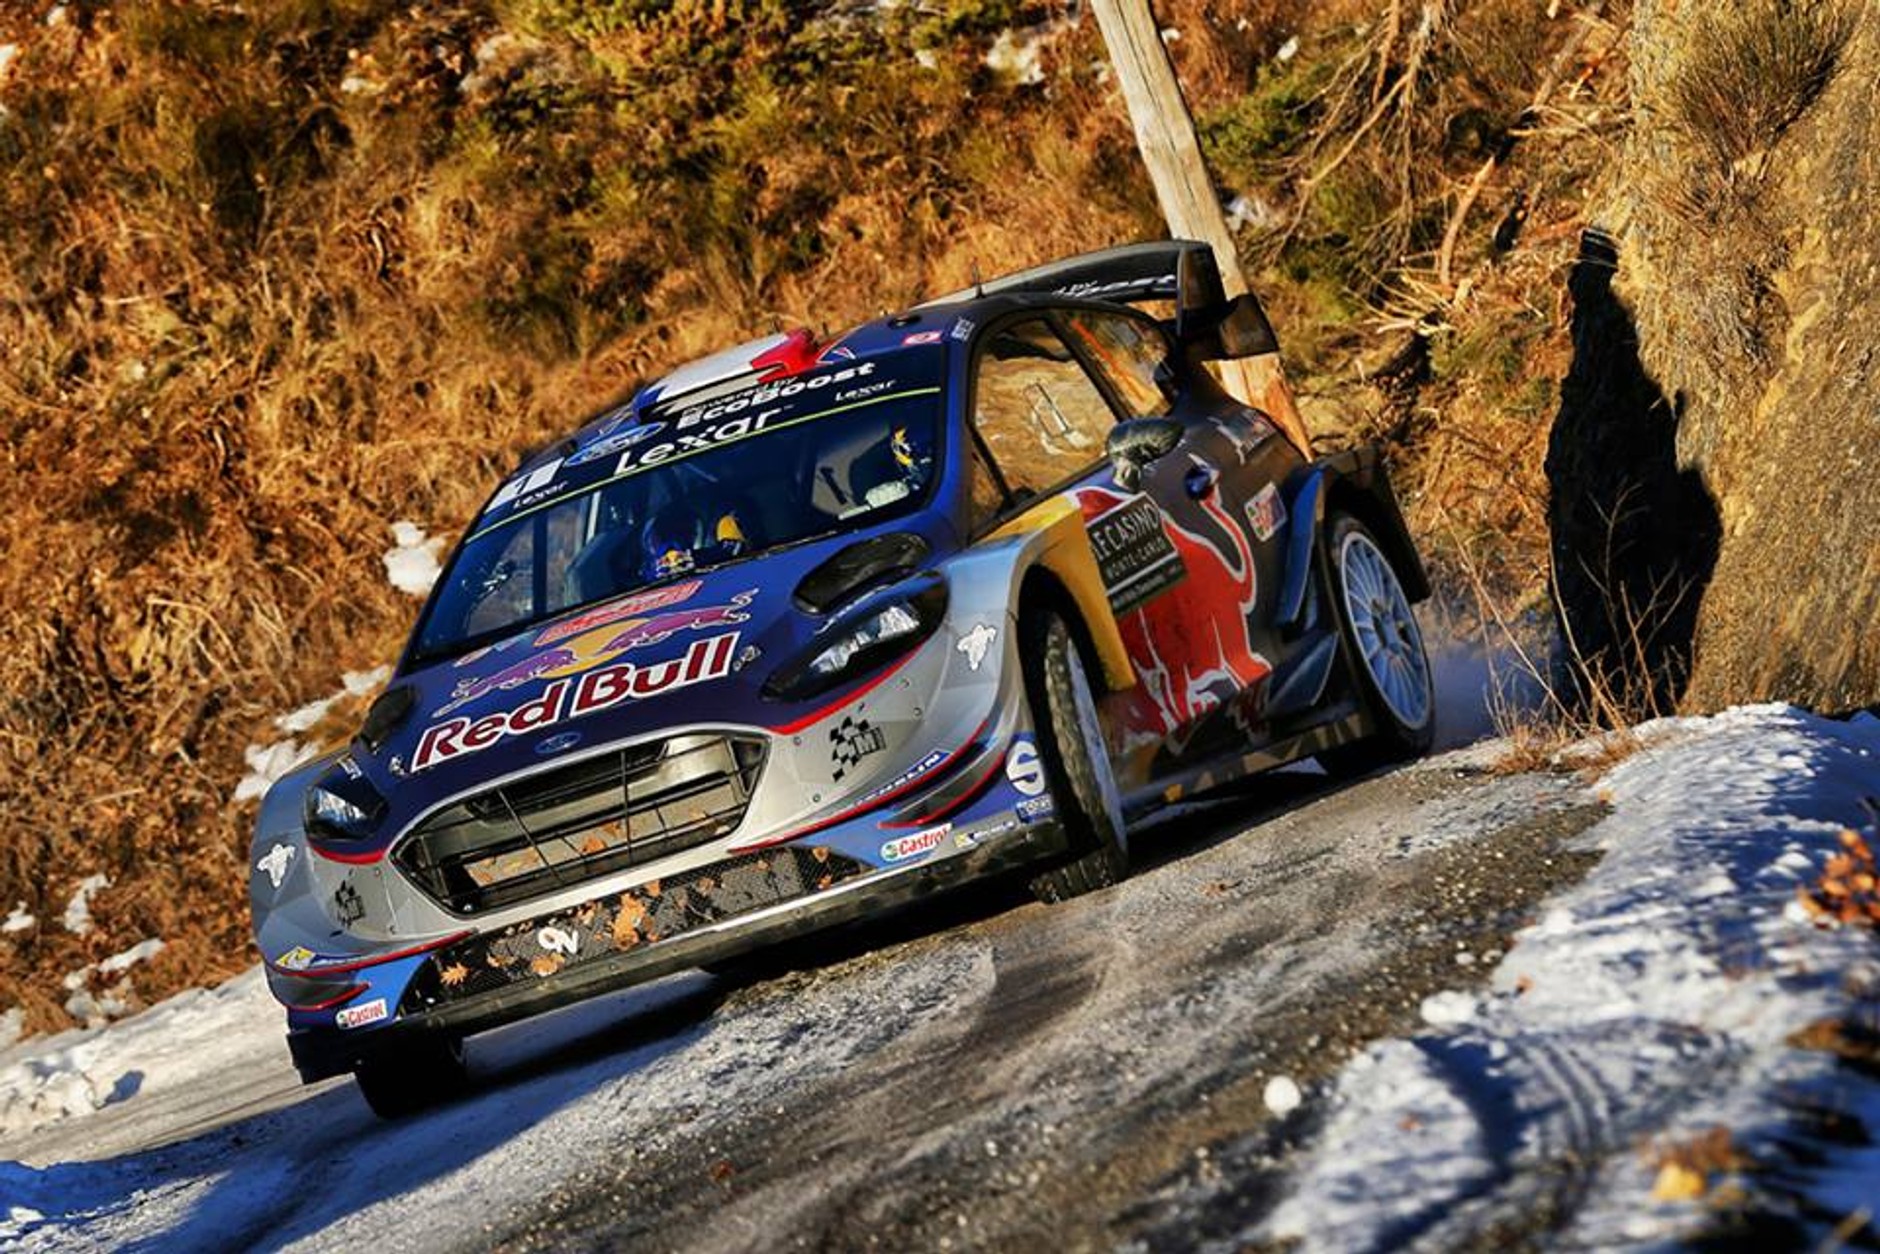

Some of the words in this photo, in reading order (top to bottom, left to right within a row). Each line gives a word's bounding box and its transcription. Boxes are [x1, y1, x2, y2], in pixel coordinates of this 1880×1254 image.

[677, 362, 876, 430] EcoBoost
[834, 379, 897, 402] Lexar
[614, 408, 782, 476] Lexar
[513, 481, 569, 509] Lexar
[412, 679, 571, 772] Red
[570, 632, 740, 717] Bull
[899, 827, 949, 856] Castrol
[346, 1001, 386, 1027] Castrol
